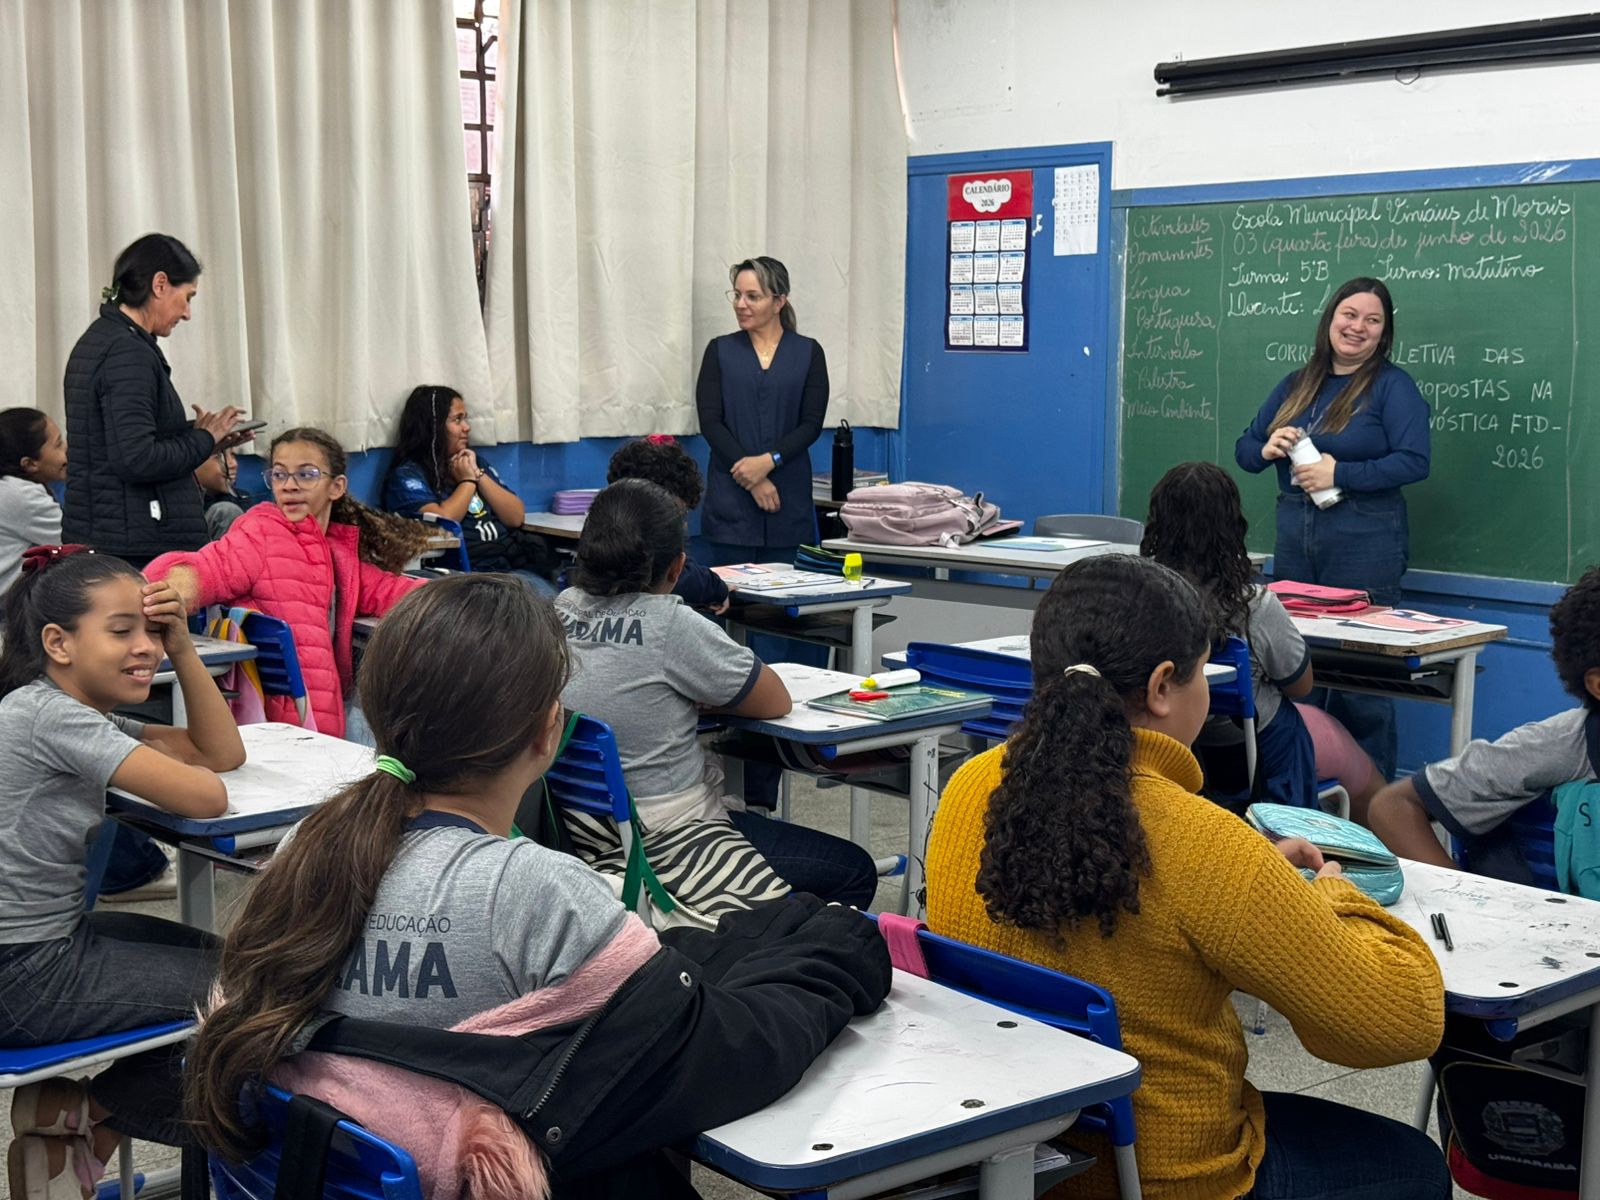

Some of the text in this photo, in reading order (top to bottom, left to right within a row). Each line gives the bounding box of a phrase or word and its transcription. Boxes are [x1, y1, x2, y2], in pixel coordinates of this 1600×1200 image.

[965, 183, 1010, 195] CALENDÁRIO
[1232, 203, 1283, 230] Escola
[1283, 197, 1381, 234] Municipal
[1462, 199, 1489, 225] de
[1491, 194, 1571, 219] Morais
[1233, 232, 1257, 255] 03
[1415, 221, 1474, 258] junho
[1479, 223, 1506, 246] de
[1512, 216, 1567, 243] 2026
[1228, 262, 1289, 286] Turma:
[1376, 253, 1440, 281] Turno:
[1443, 254, 1545, 281] Matutino
[1227, 291, 1305, 317] Docente:
[1265, 341, 1525, 365] CORRE LETIVA DAS
[1415, 378, 1553, 411] ROPOSTAS NA
[1429, 406, 1498, 432] NÓSTICA
[1491, 444, 1544, 469] 2026
[368, 914, 451, 937] EDUCAÇÃO
[335, 937, 459, 999] AMA
